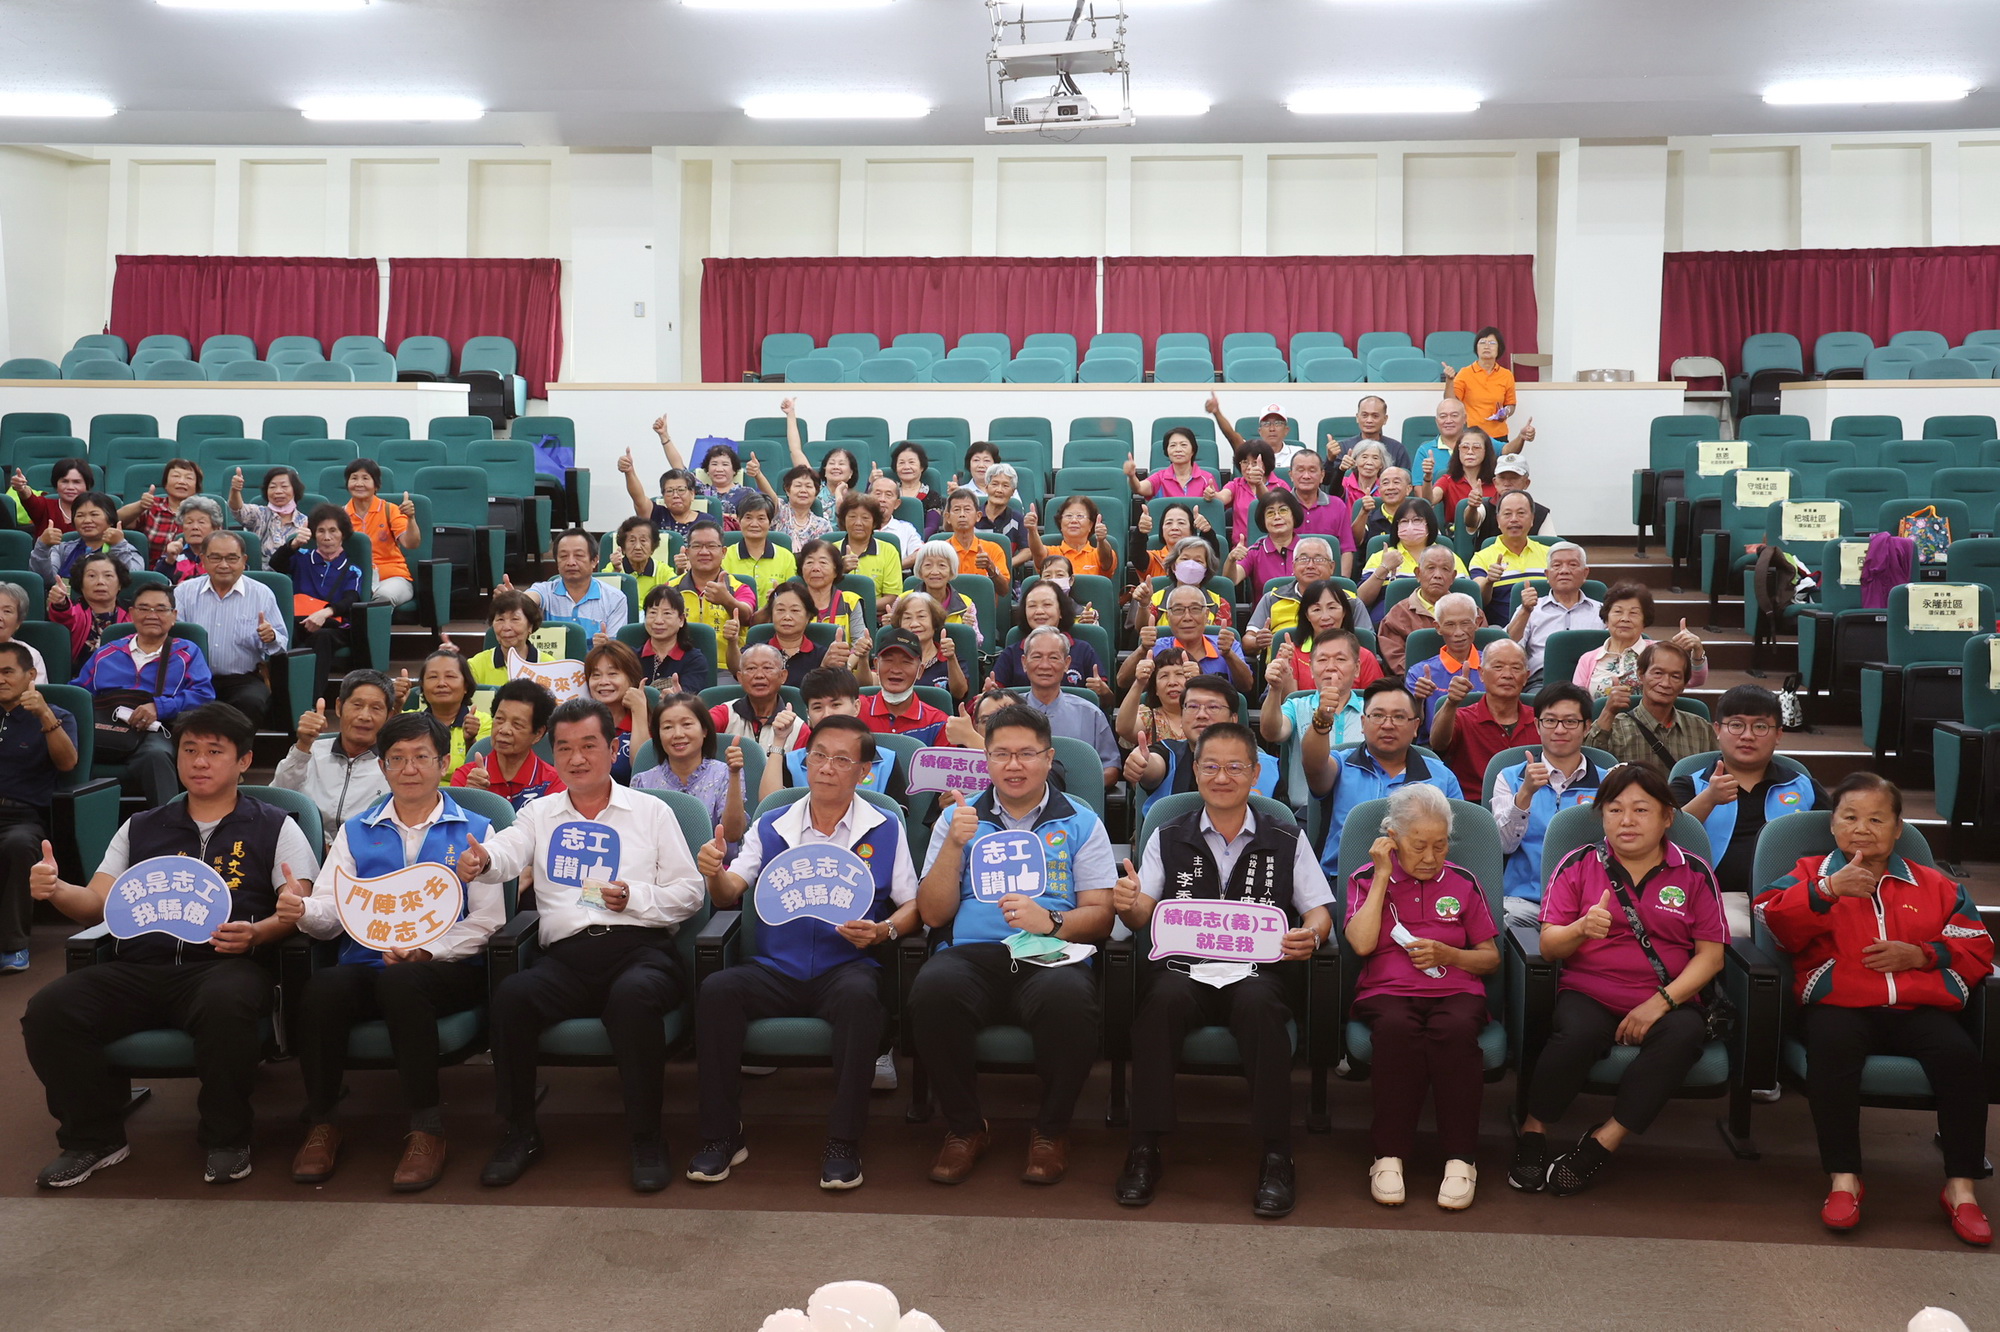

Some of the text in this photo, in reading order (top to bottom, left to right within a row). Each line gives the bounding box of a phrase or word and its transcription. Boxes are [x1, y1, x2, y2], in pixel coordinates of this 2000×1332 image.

[1922, 599, 1963, 609] 永隆社區
[560, 827, 611, 853] 志工
[981, 839, 1032, 865] 志工
[445, 844, 456, 865] 主任
[552, 854, 580, 880] 讚
[1193, 855, 1203, 877] 主任
[120, 870, 221, 904] 我是志工
[767, 856, 864, 892] 我是志工
[980, 870, 1006, 896] 讚
[344, 876, 449, 915] 鬥陣來去
[780, 884, 855, 913] 我驕傲
[131, 898, 210, 927] 我驕傲
[366, 909, 444, 942] 做志工
[1163, 908, 1278, 933] 績優志(義)工
[1196, 932, 1255, 953] 就是我
